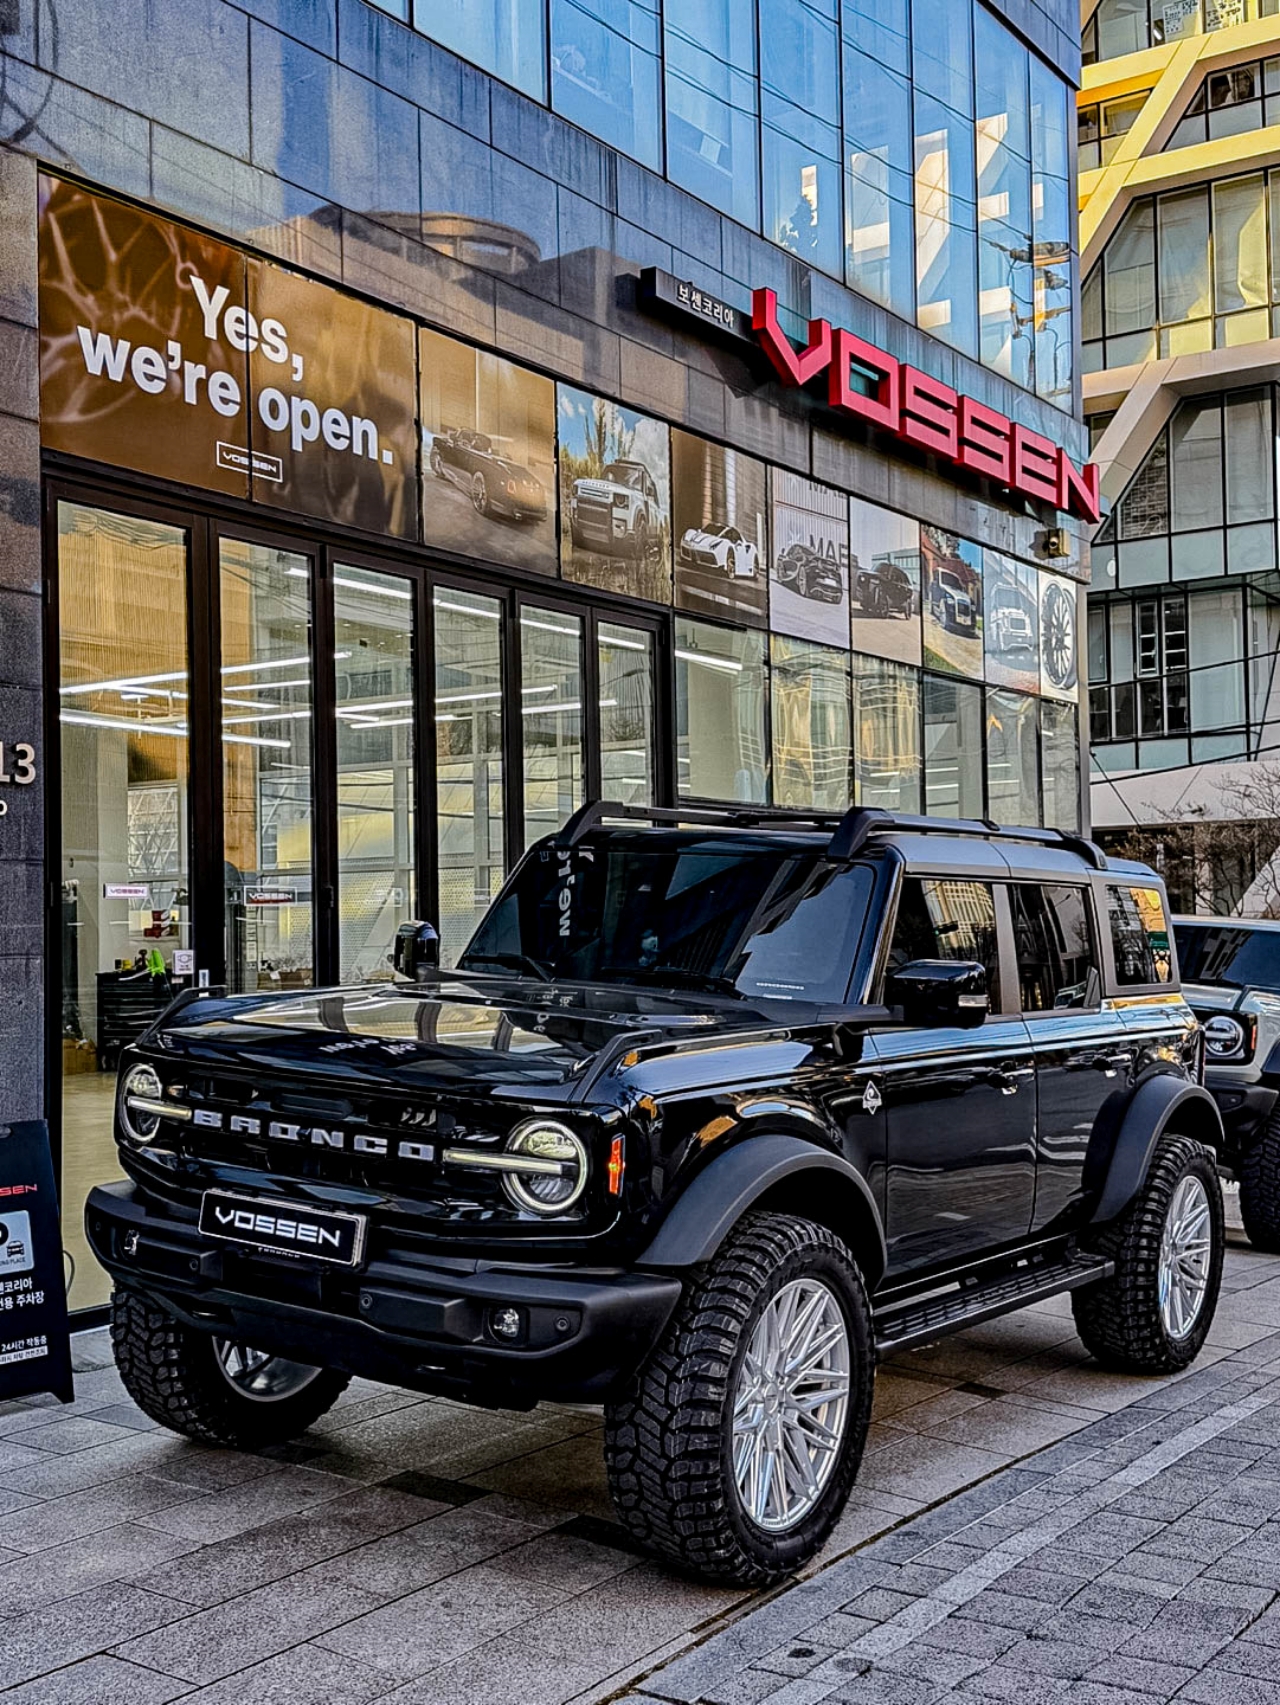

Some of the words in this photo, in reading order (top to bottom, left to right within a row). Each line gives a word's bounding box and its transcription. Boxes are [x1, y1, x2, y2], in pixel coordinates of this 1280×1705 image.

[678, 284, 734, 328] 보센코리아
[190, 275, 303, 381] Yes,
[77, 325, 240, 417] we're
[258, 387, 393, 465] open.
[752, 287, 1100, 524] VOSSEN
[222, 451, 277, 473] VOSSEN
[248, 892, 293, 901] VOSSEN
[193, 1108, 434, 1161] BRONCO
[214, 1206, 341, 1247] VOSSEN
[16, 1290, 44, 1307] 주차장
[1, 1339, 25, 1352] 24시간
